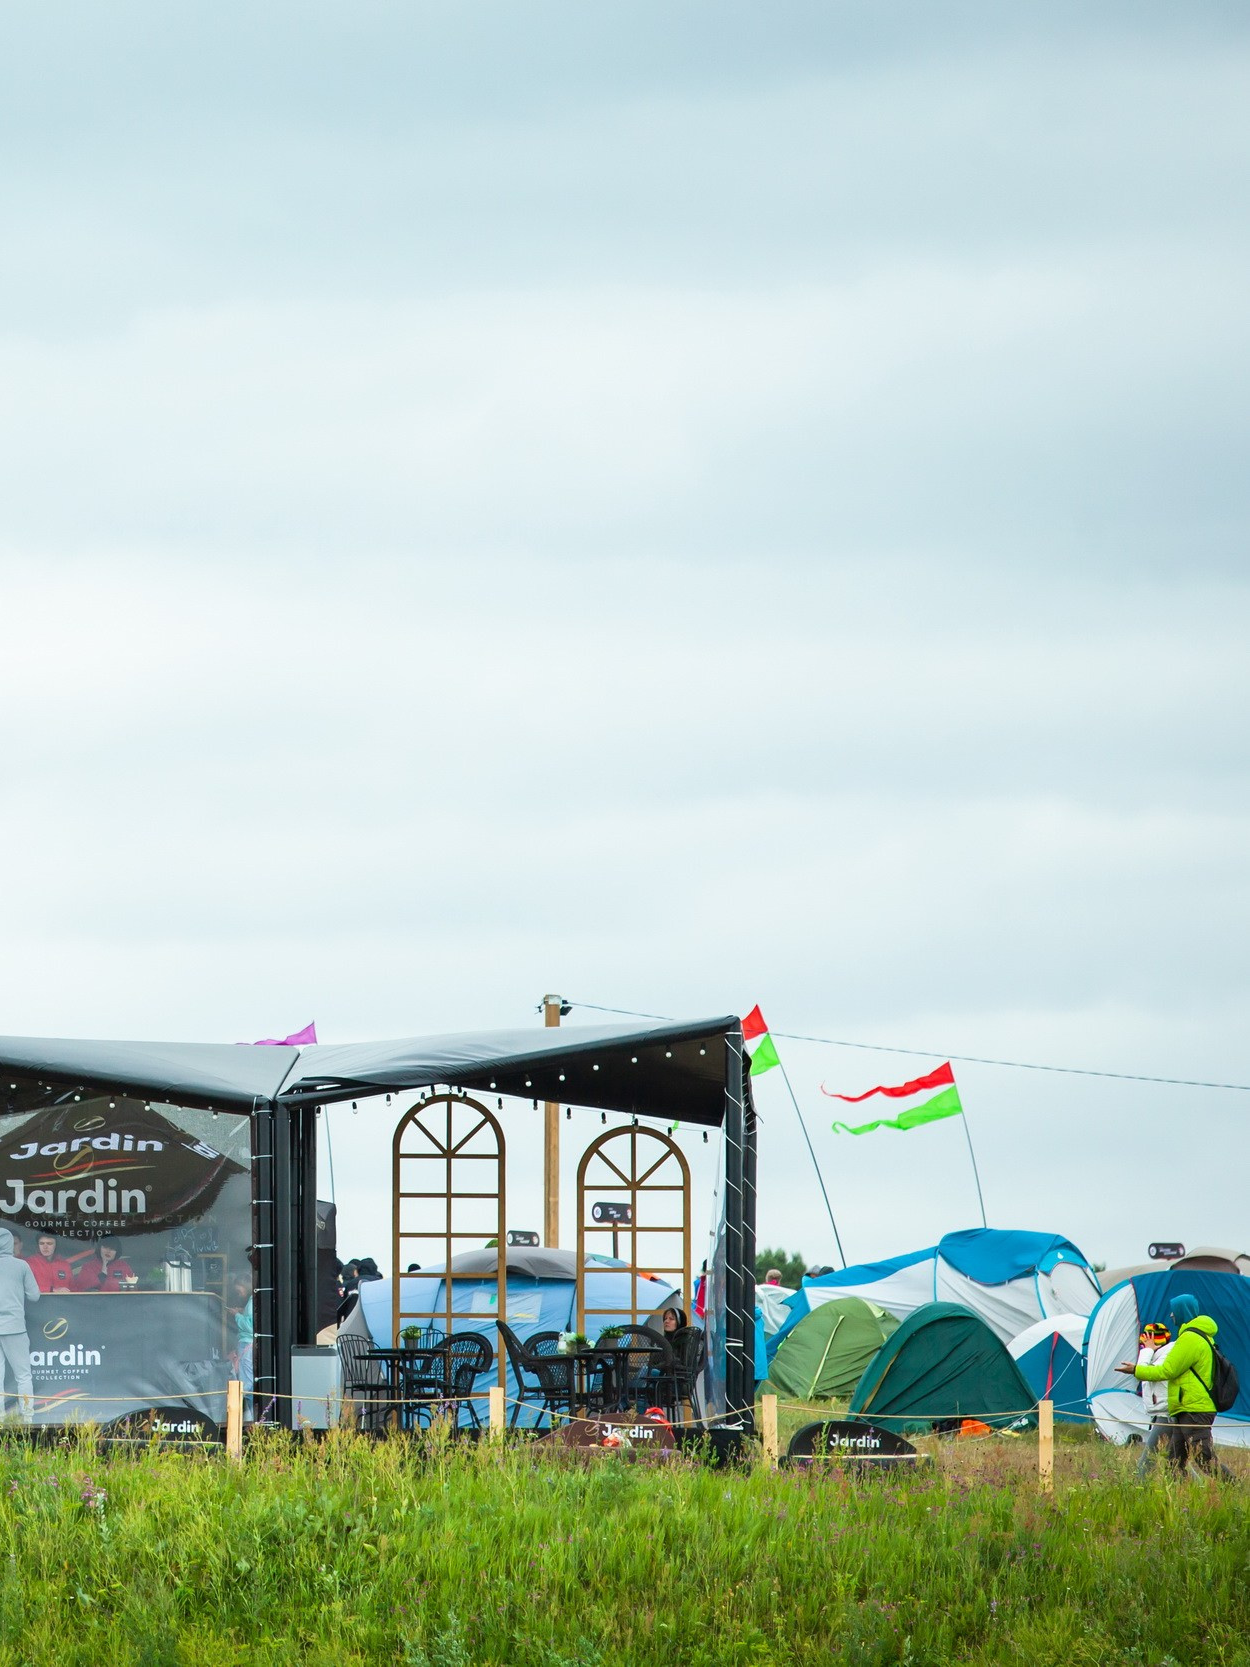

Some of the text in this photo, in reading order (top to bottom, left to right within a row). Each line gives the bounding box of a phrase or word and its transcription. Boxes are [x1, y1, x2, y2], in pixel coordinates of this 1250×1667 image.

[9, 1132, 164, 1160] Jardin
[24, 1220, 76, 1228] GOURMET
[29, 1343, 101, 1366] ardin
[151, 1418, 200, 1433] Jardin
[602, 1423, 654, 1439] Jdin
[830, 1433, 881, 1448] Jardin
